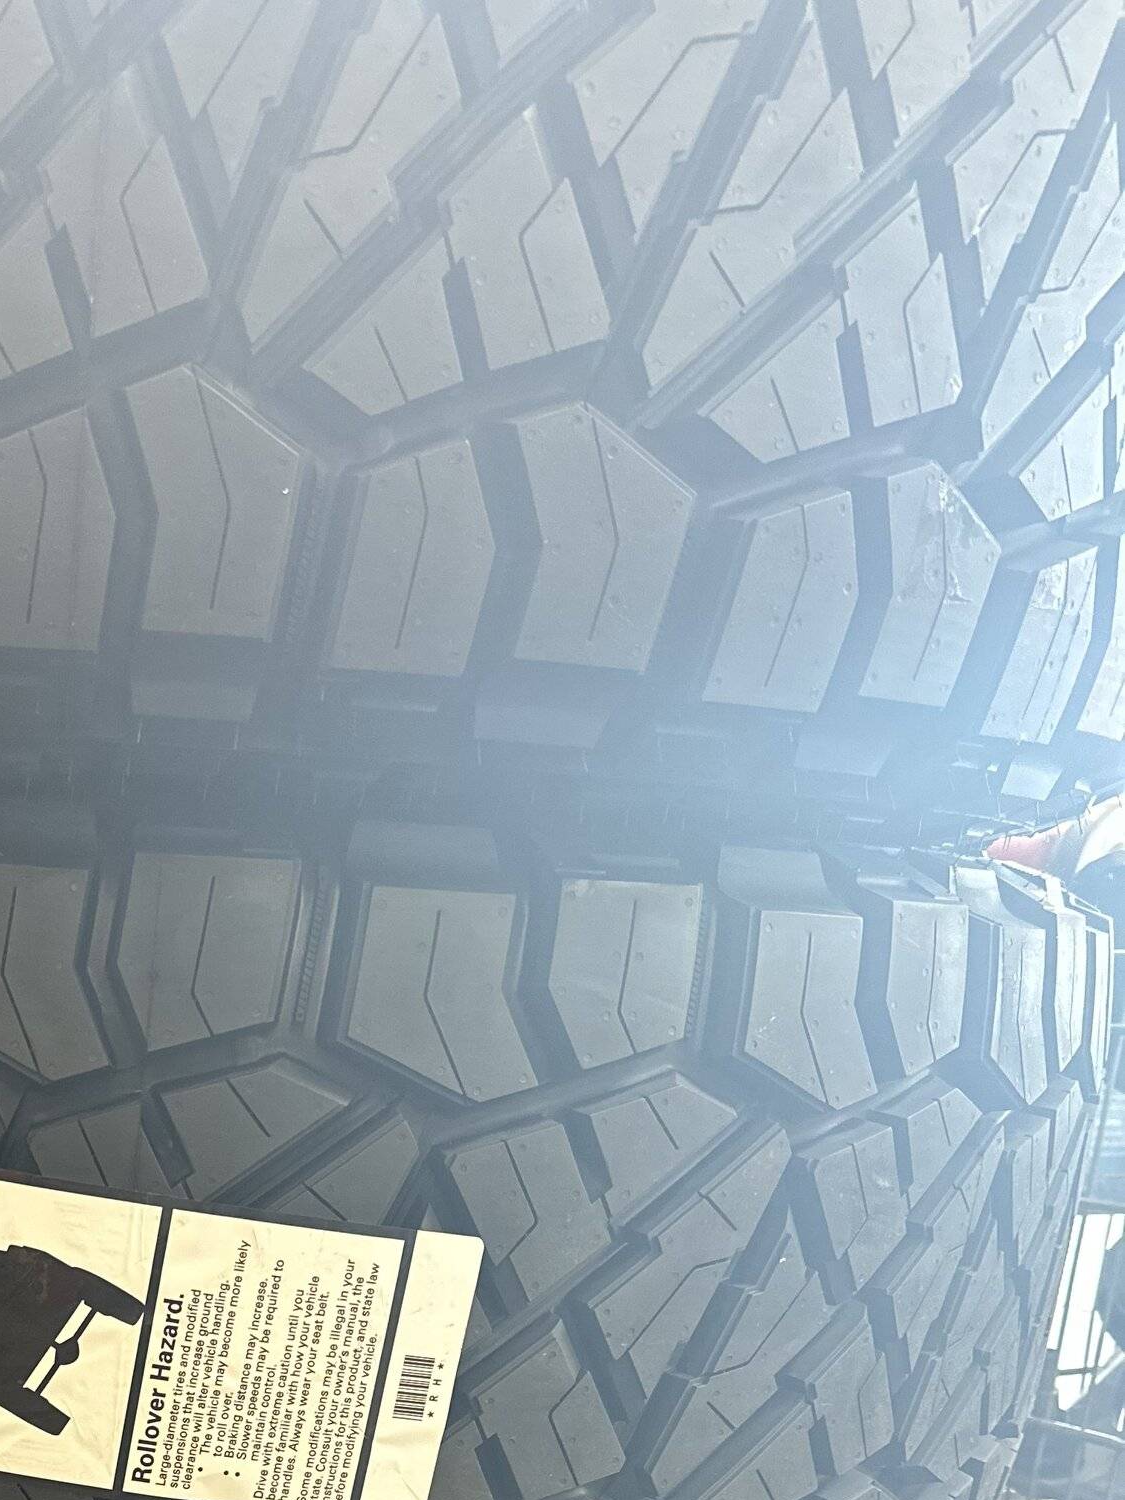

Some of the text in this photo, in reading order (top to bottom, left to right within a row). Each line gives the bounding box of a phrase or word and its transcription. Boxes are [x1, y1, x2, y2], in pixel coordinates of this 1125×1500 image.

[342, 1258, 358, 1287] your
[350, 1276, 364, 1296] the
[365, 1262, 379, 1284] law
[314, 1290, 329, 1316] belt.
[337, 1290, 349, 1301] in
[359, 1287, 374, 1316] state
[309, 1319, 323, 1344] seat
[329, 1304, 348, 1340] illegal
[340, 1298, 360, 1347] manual,
[353, 1319, 367, 1342] and
[198, 1239, 251, 1455] The vehicle may become more likely
[223, 1277, 267, 1458] Braking distance may increase.
[235, 1258, 284, 1460] Slower speeds may be required to
[305, 1347, 320, 1375] your
[325, 1343, 338, 1358] be
[358, 1332, 377, 1378] vehicle.
[131, 1291, 184, 1483] Rollover Hazard.
[155, 1288, 200, 1486] Large-diameter tires and modified
[167, 1292, 216, 1488] suspensions that increase ground
[180, 1279, 231, 1489] clearance will alter vehicle handling.
[265, 1275, 319, 1500] become familiar with how your vehicle
[299, 1377, 311, 1406] wear
[322, 1361, 337, 1387] may
[330, 1349, 349, 1396] owner's
[343, 1345, 365, 1394] product,
[248, 1363, 276, 1461] maintain control.
[253, 1289, 306, 1499] Drive with extreme caution until you
[326, 1398, 341, 1426] your
[337, 1396, 351, 1418] this
[354, 1380, 369, 1408] your
[210, 1391, 232, 1457] to roll over.
[287, 1408, 307, 1452] Always
[303, 1389, 328, 1468] modifications
[333, 1420, 346, 1438] for
[339, 1410, 363, 1468] modifying
[314, 1428, 332, 1472] Consult
